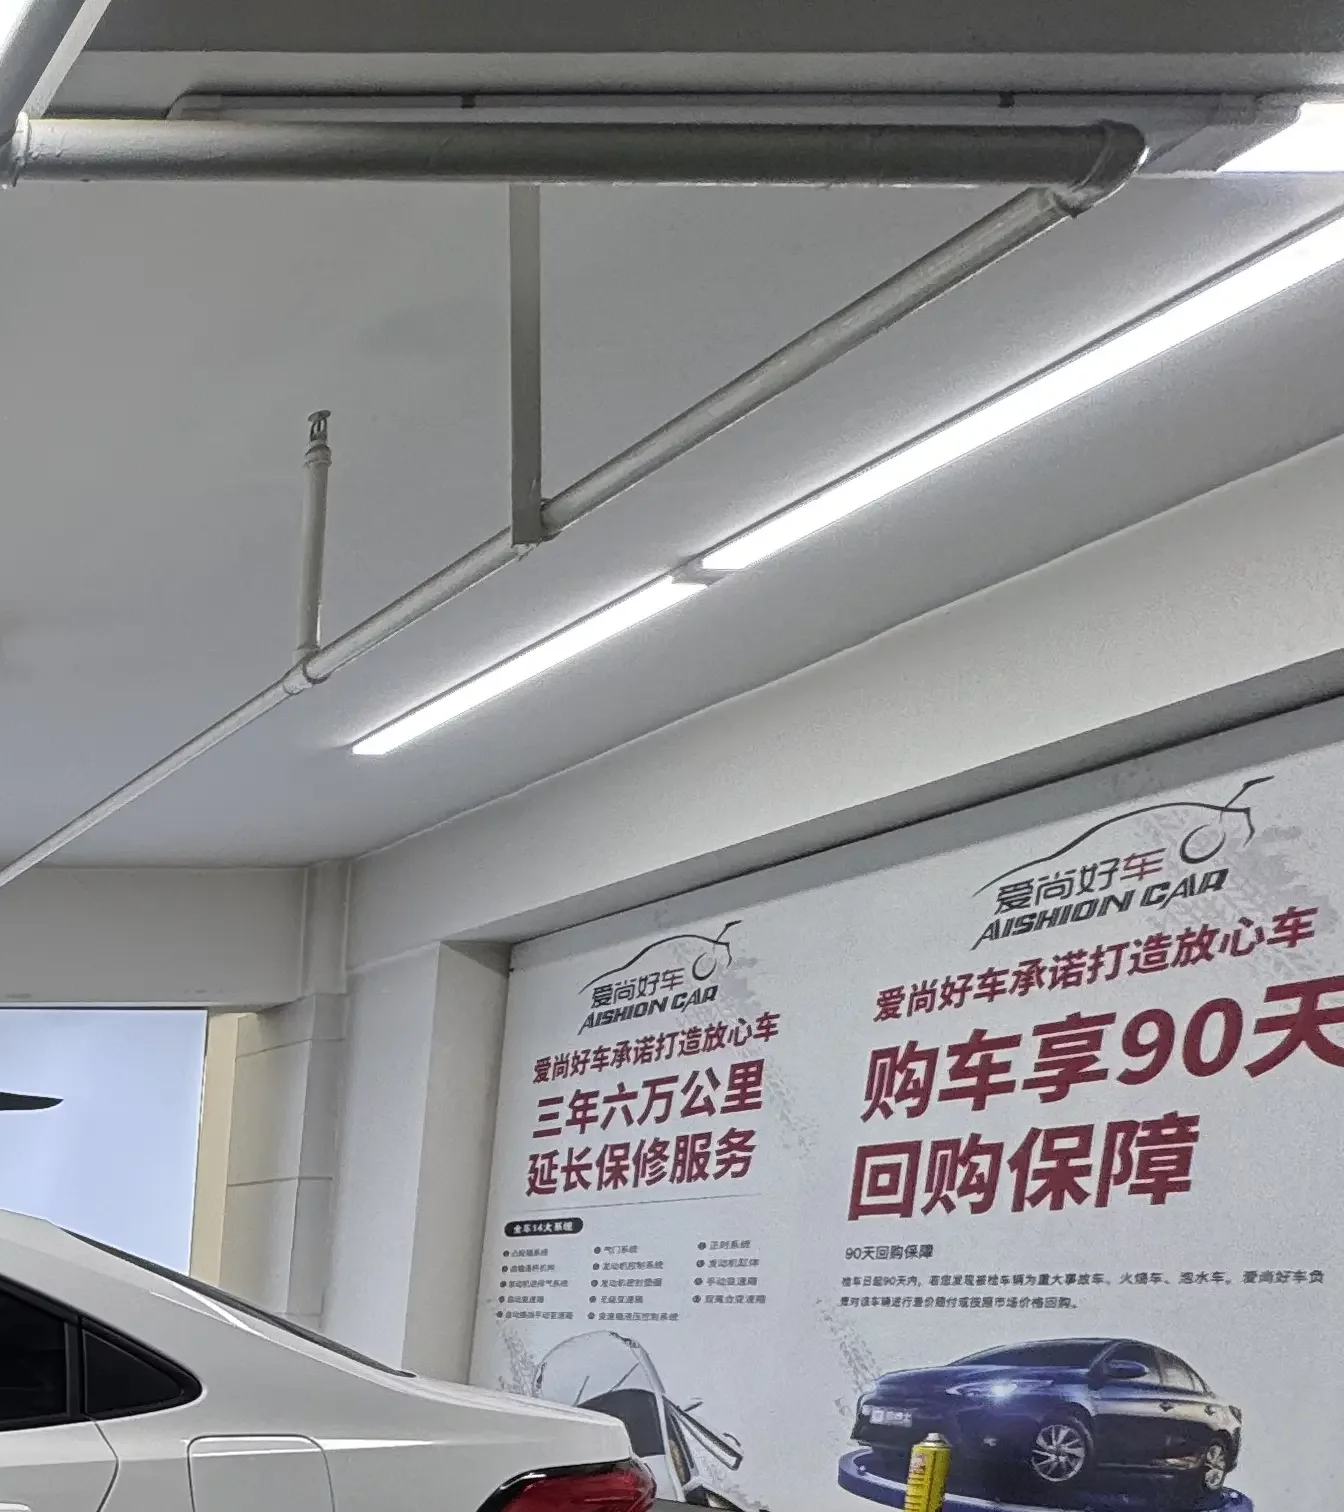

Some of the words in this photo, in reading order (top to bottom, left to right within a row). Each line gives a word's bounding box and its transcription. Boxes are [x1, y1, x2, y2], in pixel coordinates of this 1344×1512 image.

[970, 894, 1134, 951] AISHION
[1140, 868, 1229, 910] CAR
[994, 847, 1166, 915] 爱尚好车
[591, 967, 685, 1008] 爱尚好车
[873, 906, 1318, 1022] 爱尚好车承诺打造放心车
[577, 997, 668, 1035] AISHION
[670, 985, 718, 1013] CAR
[532, 1011, 781, 1084] 爱尚好车承诺打造放心车
[860, 975, 1344, 1123] 购车享90天
[532, 1058, 765, 1138] 三年六万公里
[526, 1127, 756, 1197] 延长保修服务
[847, 1110, 1200, 1221] 回购保障
[845, 1244, 934, 1260] 90天回购保障
